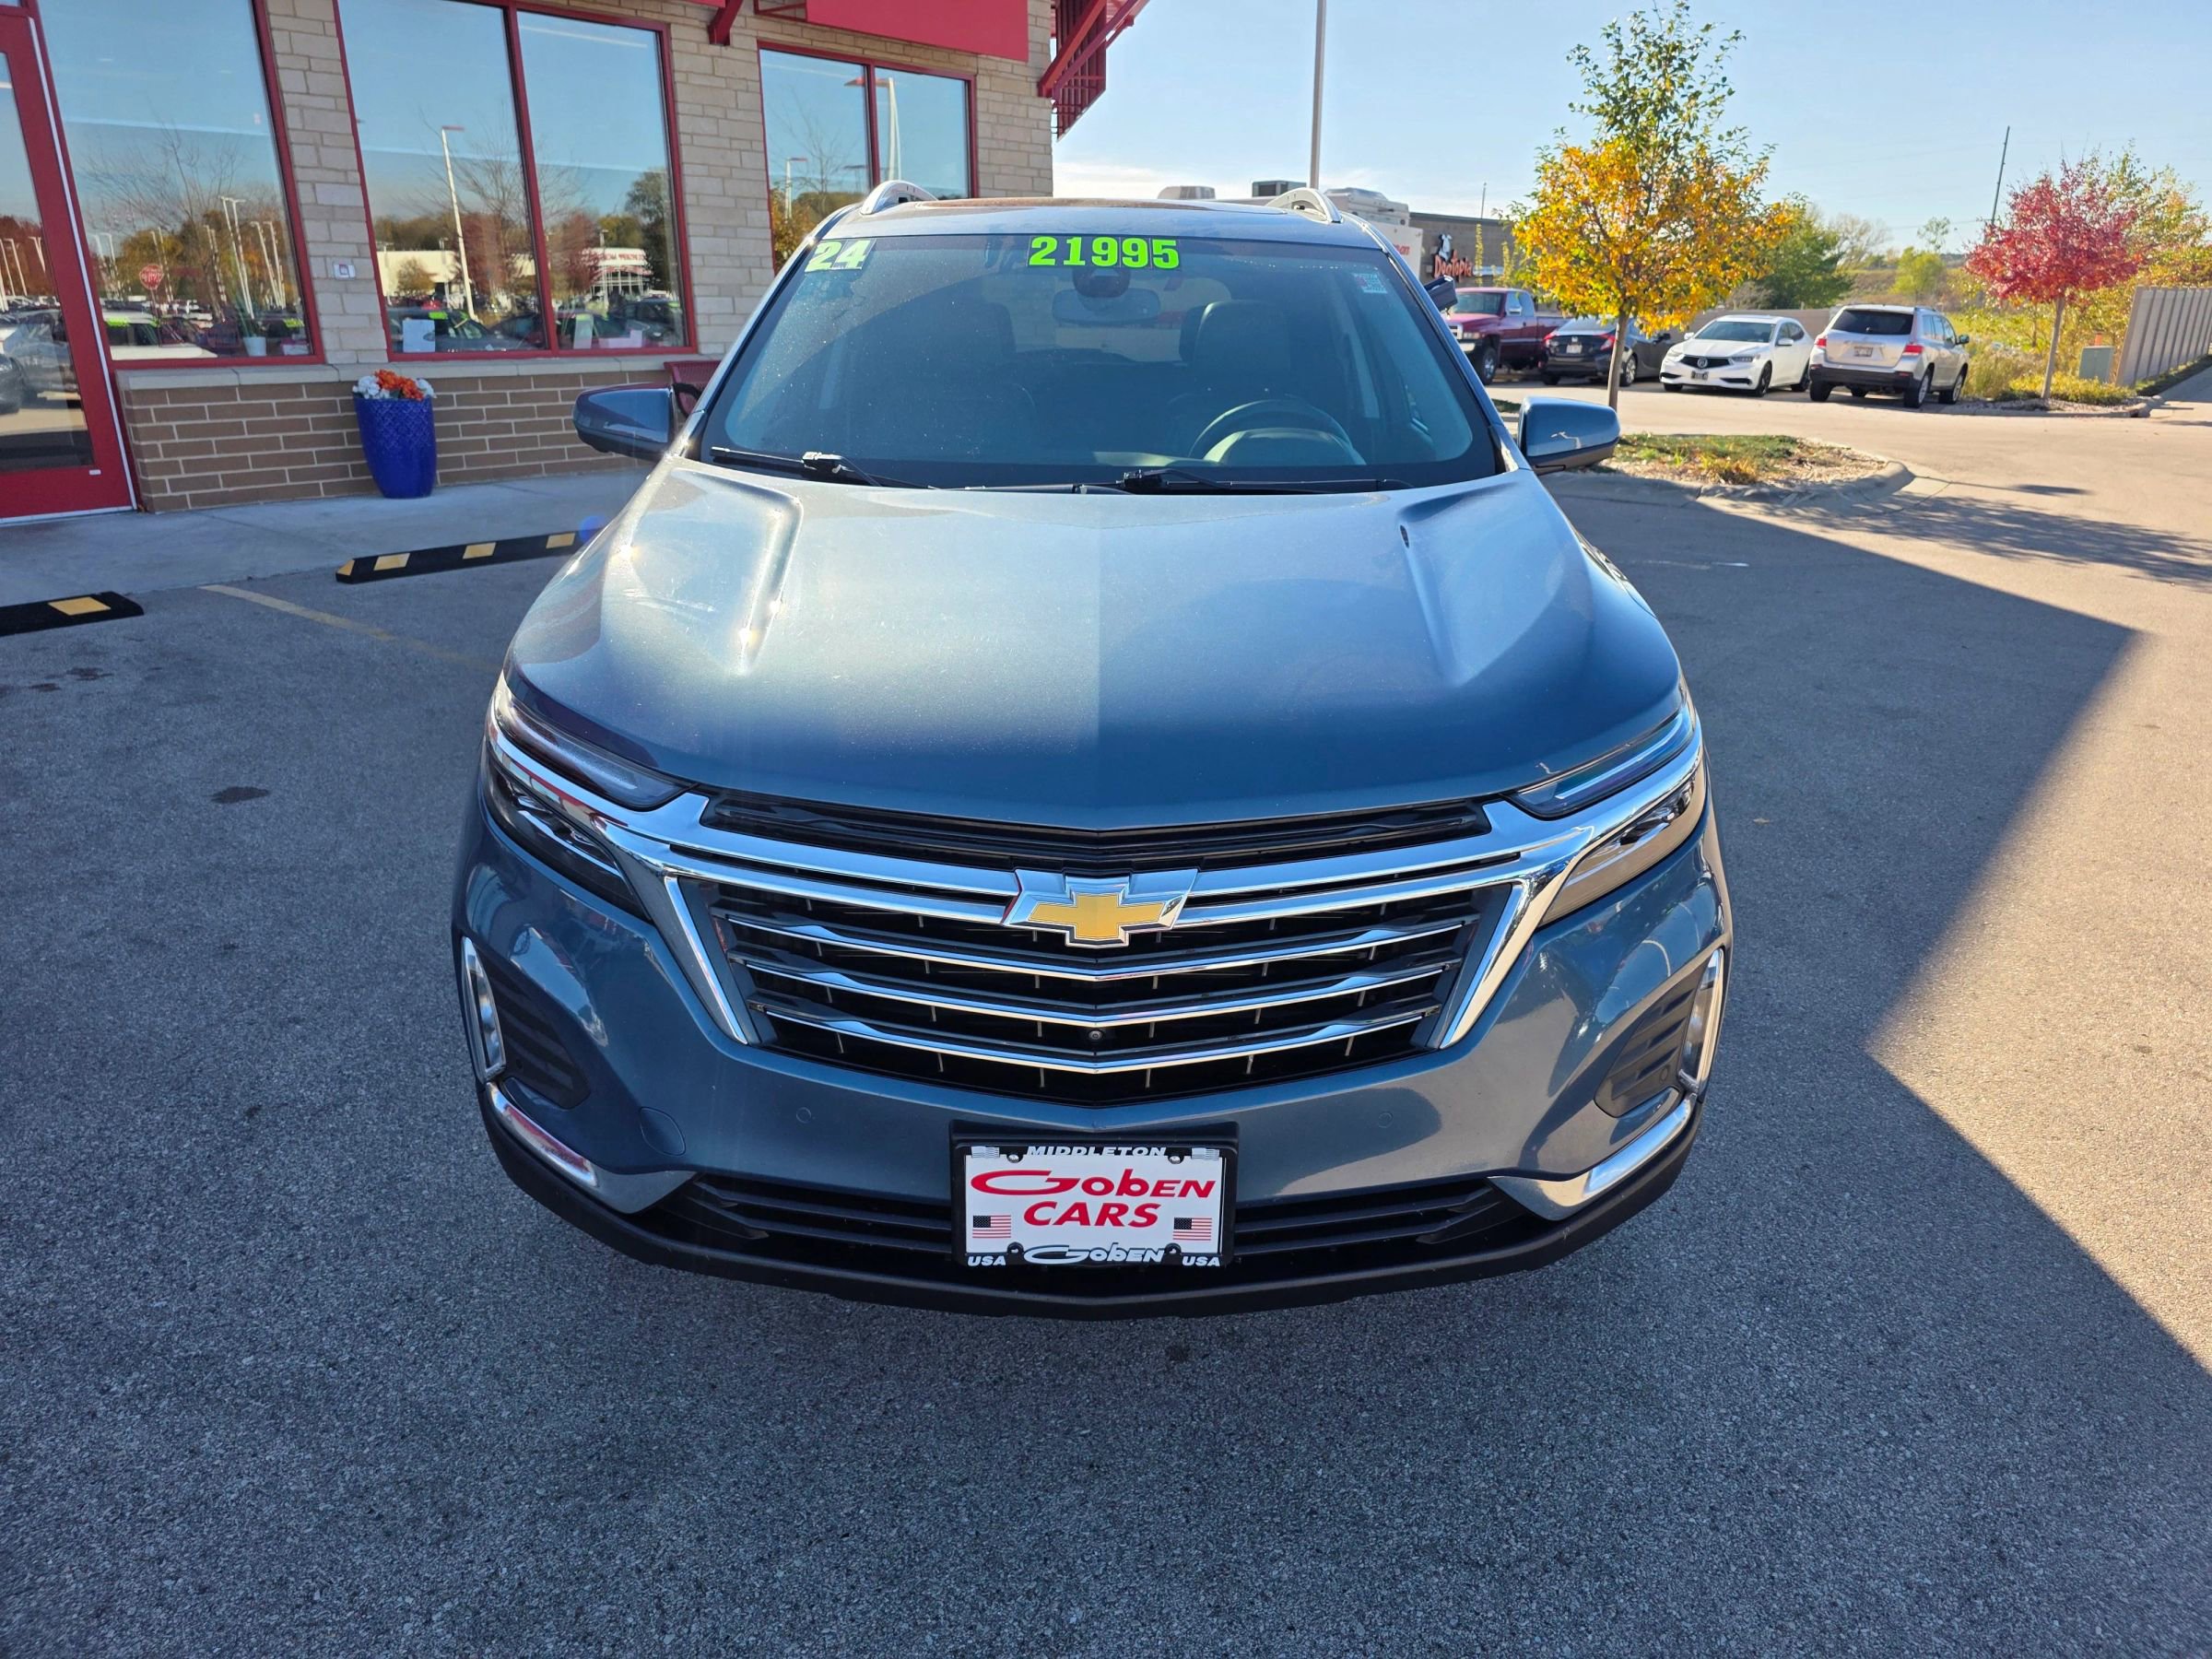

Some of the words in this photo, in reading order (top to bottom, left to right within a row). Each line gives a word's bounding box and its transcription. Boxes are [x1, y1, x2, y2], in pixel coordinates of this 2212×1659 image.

[804, 240, 871, 272] 24
[1029, 236, 1180, 269] 21995
[1026, 1146, 1166, 1157] MIDDLETON
[1023, 1201, 1162, 1228] CARS
[968, 1255, 1006, 1266] USA
[1182, 1255, 1220, 1267] USA
